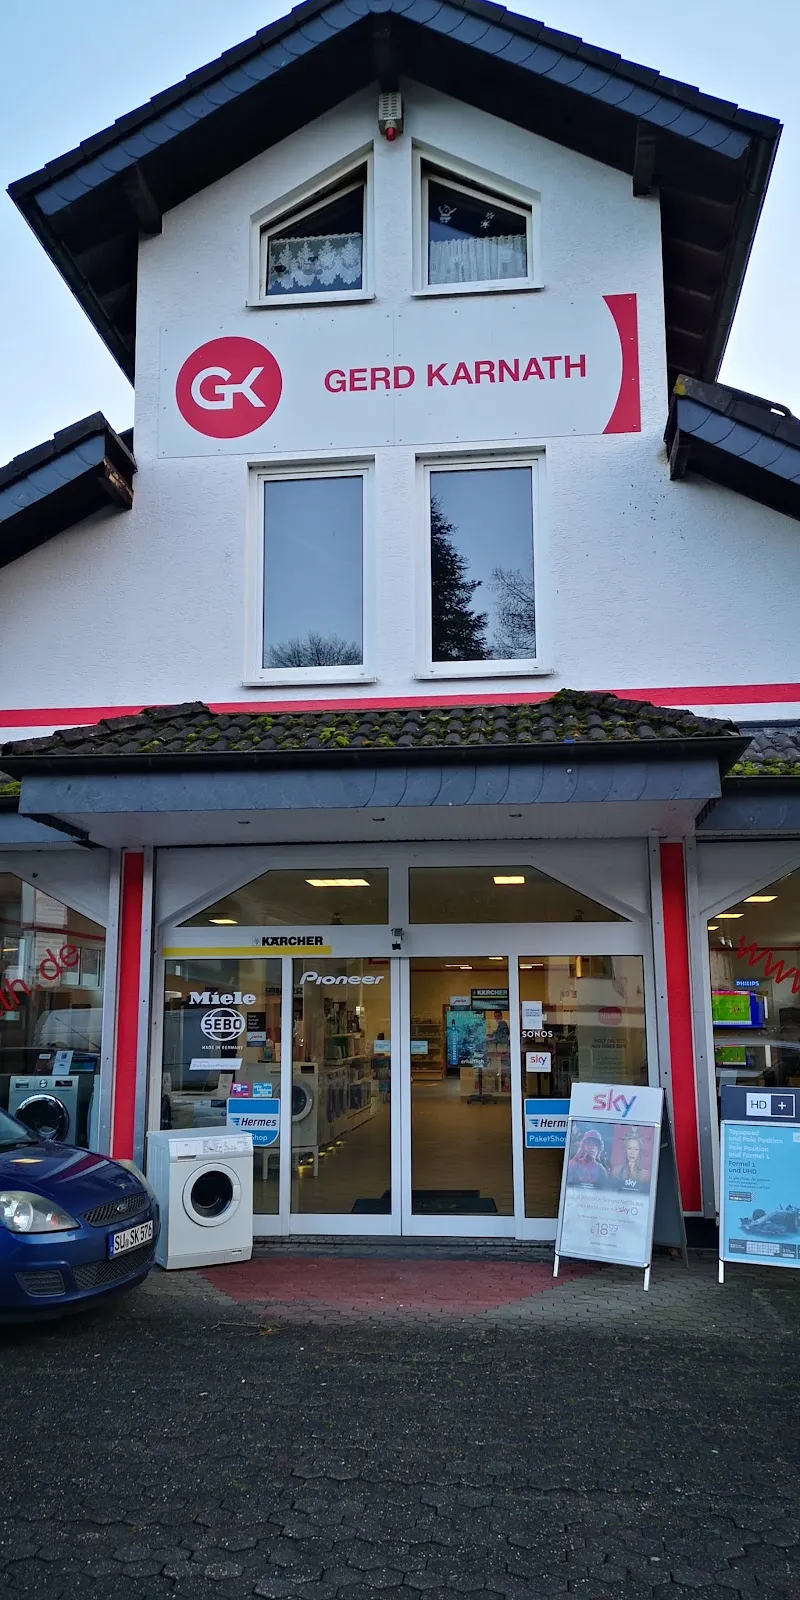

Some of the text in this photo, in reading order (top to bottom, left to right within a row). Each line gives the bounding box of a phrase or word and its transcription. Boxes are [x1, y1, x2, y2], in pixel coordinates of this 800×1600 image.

[324, 354, 587, 393] GERD KARNATH
[191, 366, 267, 410] GK
[261, 936, 323, 946] KÄRCHER
[299, 971, 385, 985] Pioneer
[188, 991, 256, 1005] Miele
[204, 1018, 242, 1030] SEBO
[521, 1030, 553, 1038] SONOS
[530, 1054, 547, 1065] sky
[592, 1088, 637, 1118] sky
[750, 1100, 767, 1109] HD
[240, 1117, 277, 1127] Hermes
[540, 1119, 568, 1128] Herm
[625, 1178, 637, 1188] sky
[618, 1206, 630, 1215] sky
[114, 1223, 152, 1251] SU SK 576
